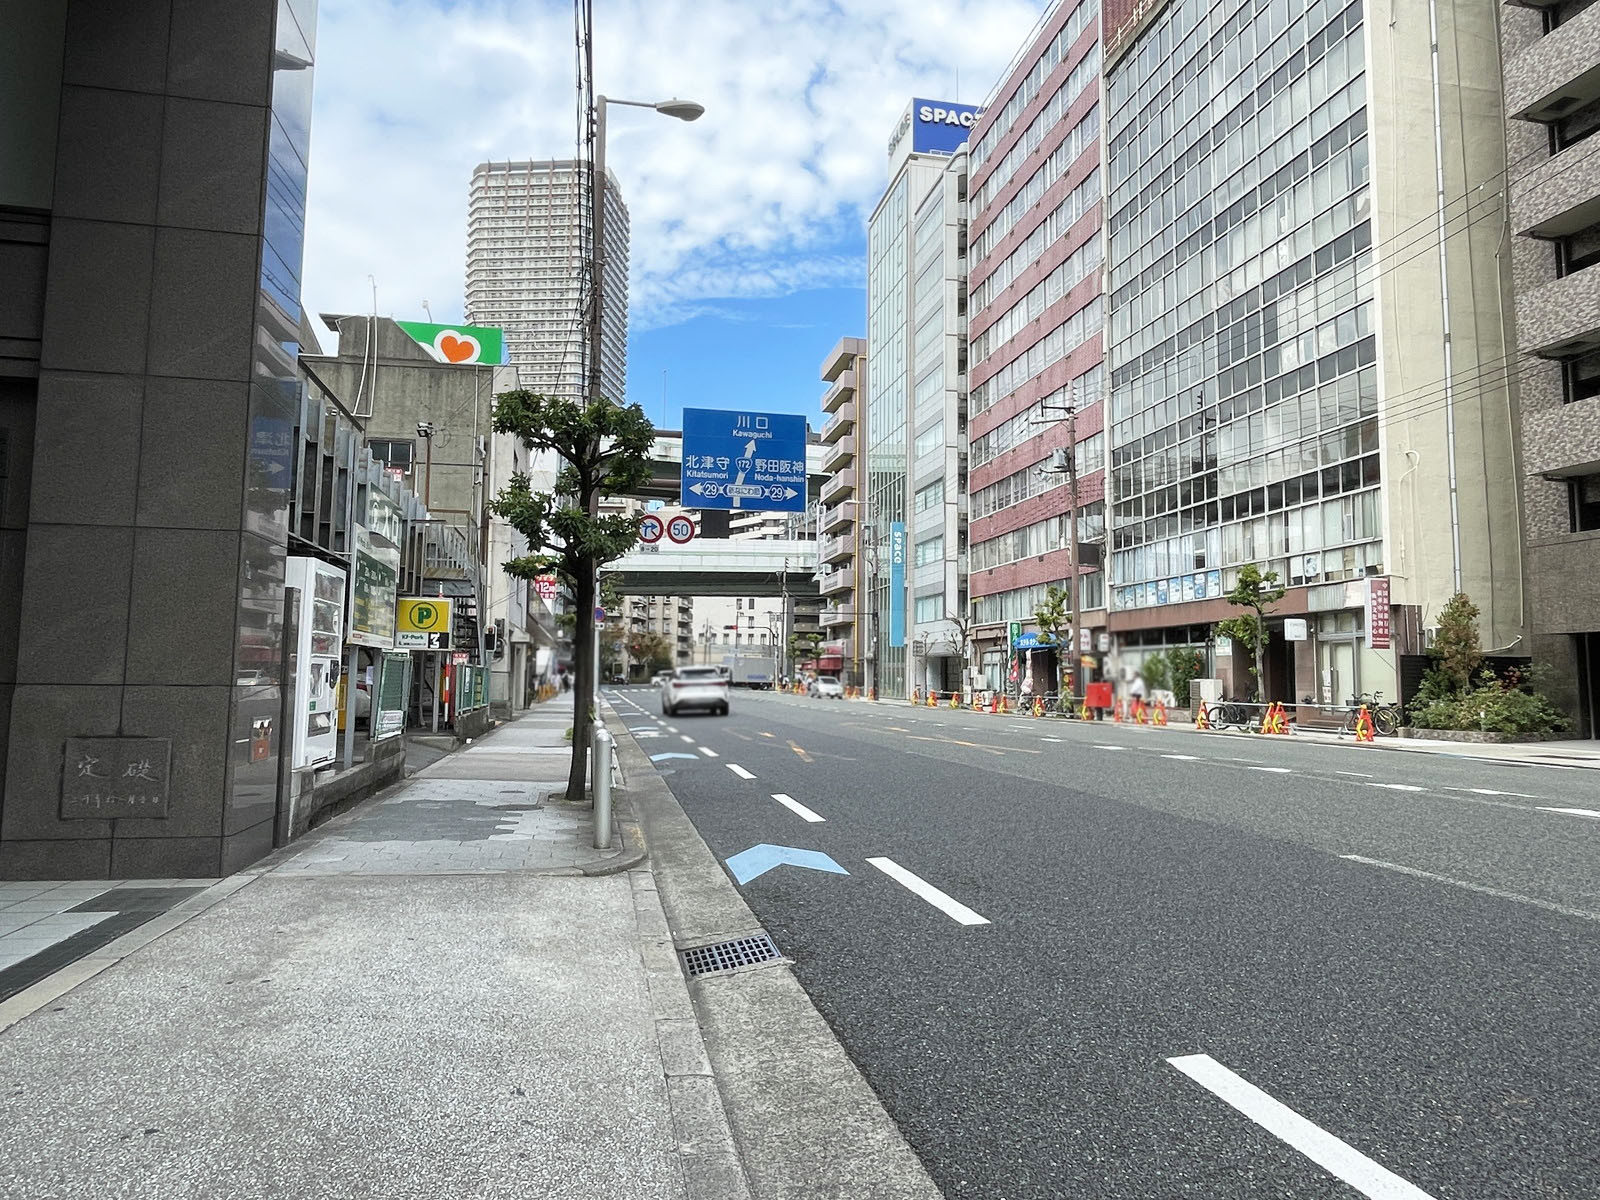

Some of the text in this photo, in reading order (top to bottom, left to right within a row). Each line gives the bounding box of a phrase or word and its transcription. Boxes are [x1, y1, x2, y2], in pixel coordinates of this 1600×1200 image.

[737, 415, 768, 429] 川口
[733, 429, 772, 438] Kawaguchi
[685, 455, 730, 470] 北津守
[738, 460, 750, 469] 172
[755, 458, 804, 473] 野田阪神
[686, 470, 729, 479] Kitatsumori
[755, 473, 804, 482] Noda-hanshin
[705, 484, 717, 495] 29
[771, 488, 783, 499] 29
[673, 523, 689, 536] 50
[417, 607, 432, 624] P
[429, 633, 440, 649] 3
[78, 754, 159, 782] 定礎
